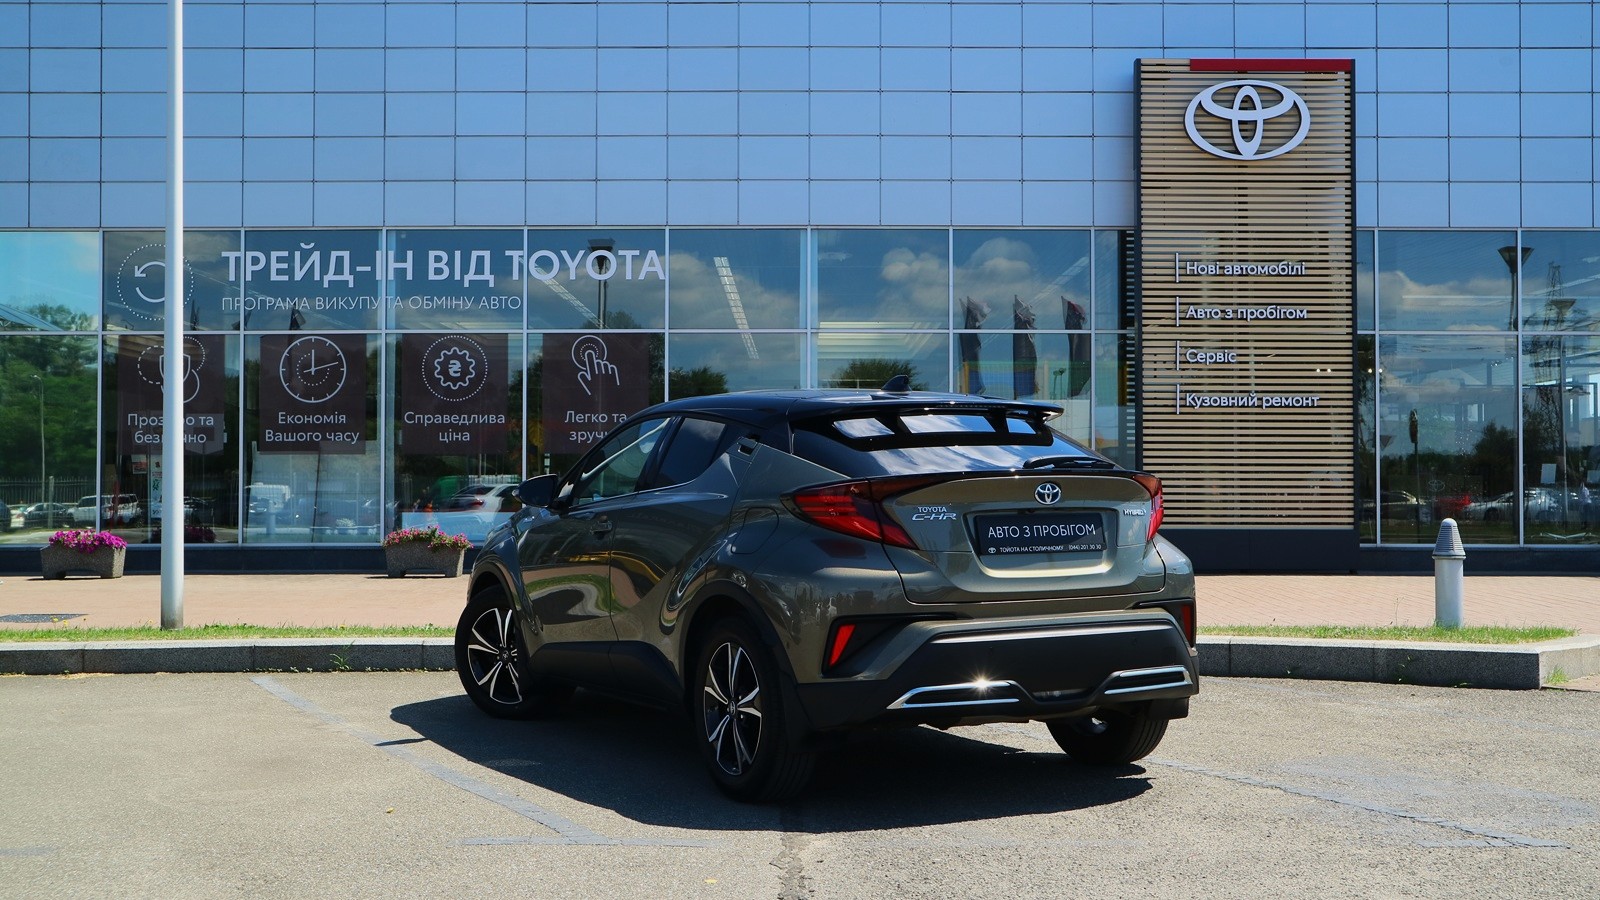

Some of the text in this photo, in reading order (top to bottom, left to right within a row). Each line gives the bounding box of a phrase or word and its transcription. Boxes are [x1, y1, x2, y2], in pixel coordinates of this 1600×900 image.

[221, 243, 666, 288] ТРЕЙД-ІН ВІД TOYOTA
[1185, 261, 1306, 276] Нові автомобілі
[221, 295, 522, 311] ПРОГРАМА ВИКУПУ ТА ОБМІНУ АВТО
[1185, 305, 1308, 322] Авто з пробігом
[1185, 349, 1237, 365] Сервіс
[1185, 392, 1320, 409] Кузовний ремонт
[198, 416, 214, 426] та
[278, 411, 347, 424] Економія
[404, 411, 506, 425] Справедлива
[564, 410, 627, 423] Легко та
[265, 429, 360, 445] Вашого часу
[438, 429, 471, 442] ціна
[569, 431, 608, 444] зруч
[911, 513, 957, 521] C-HR
[988, 523, 1096, 539] АВТО З ПРОБІГОМ
